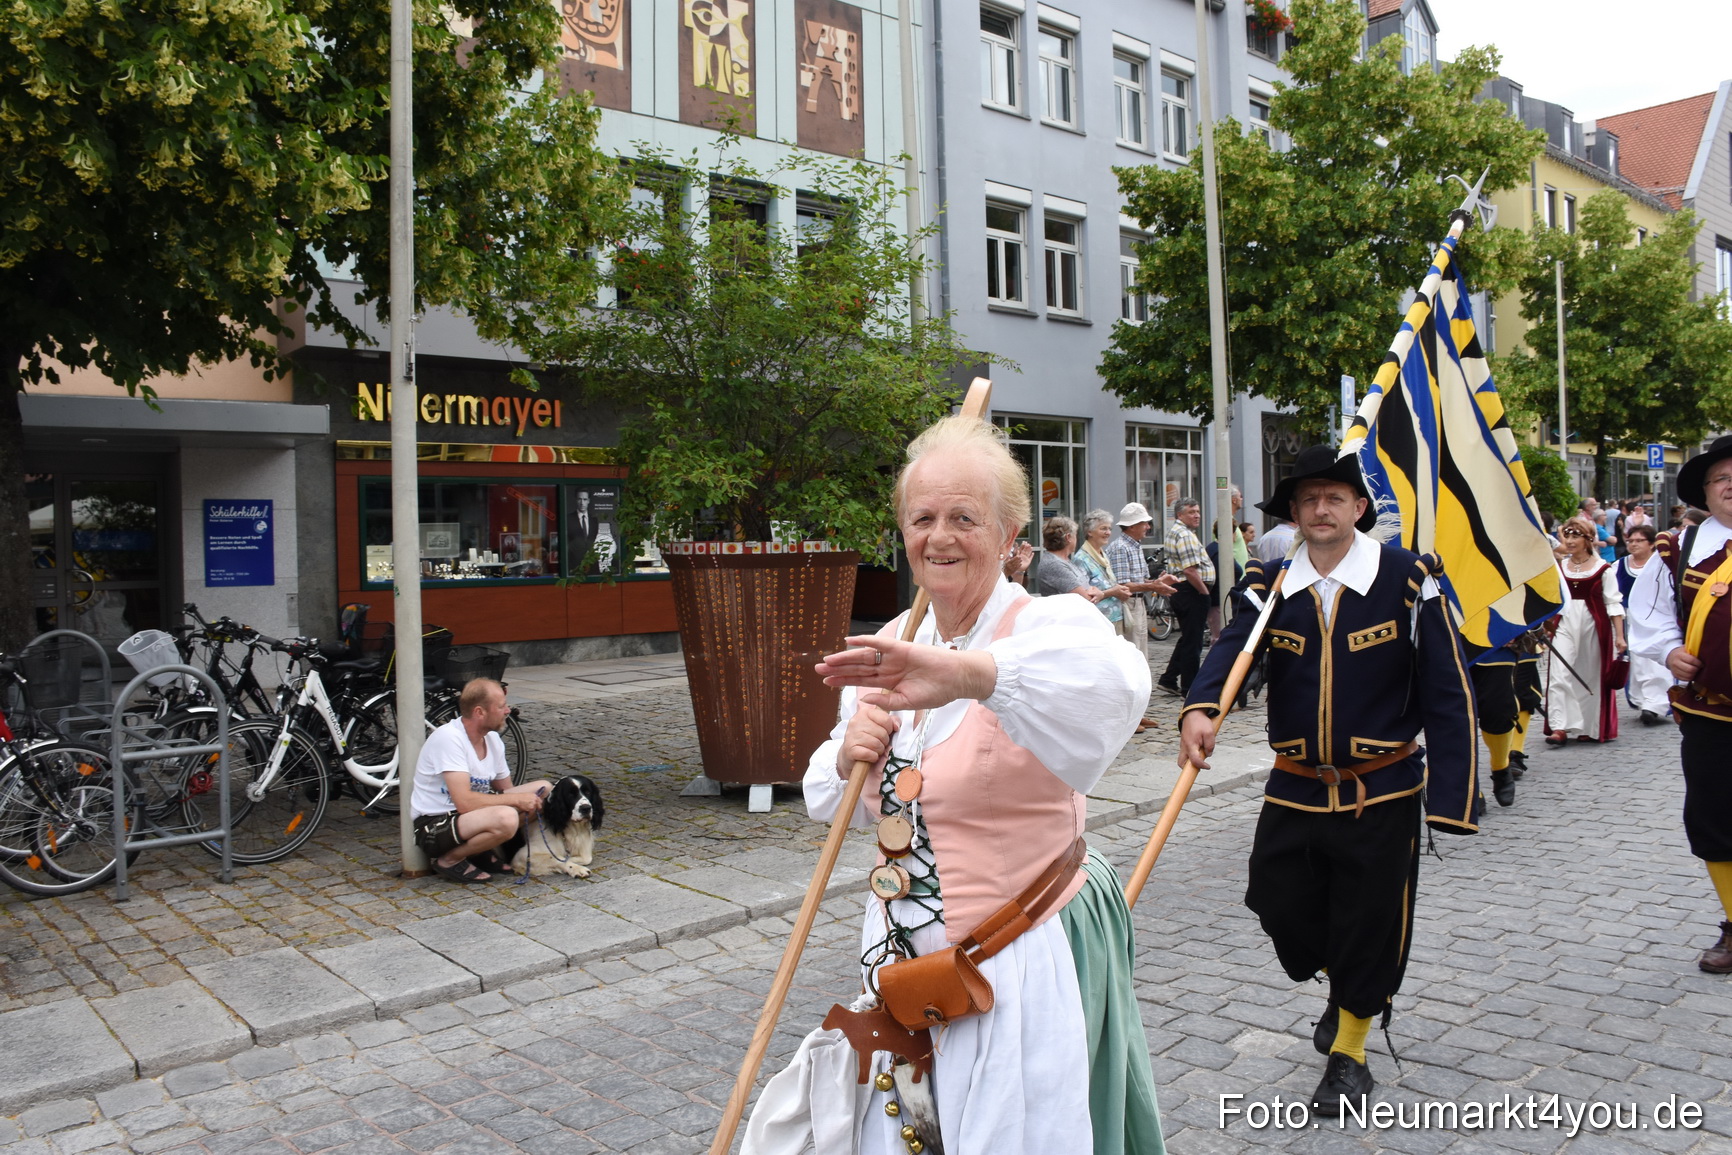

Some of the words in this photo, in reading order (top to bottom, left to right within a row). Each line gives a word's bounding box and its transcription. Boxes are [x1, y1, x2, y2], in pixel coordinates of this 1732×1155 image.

[1344, 381, 1352, 409] P
[1651, 447, 1660, 466] P
[326, 705, 343, 741] PEGASUS
